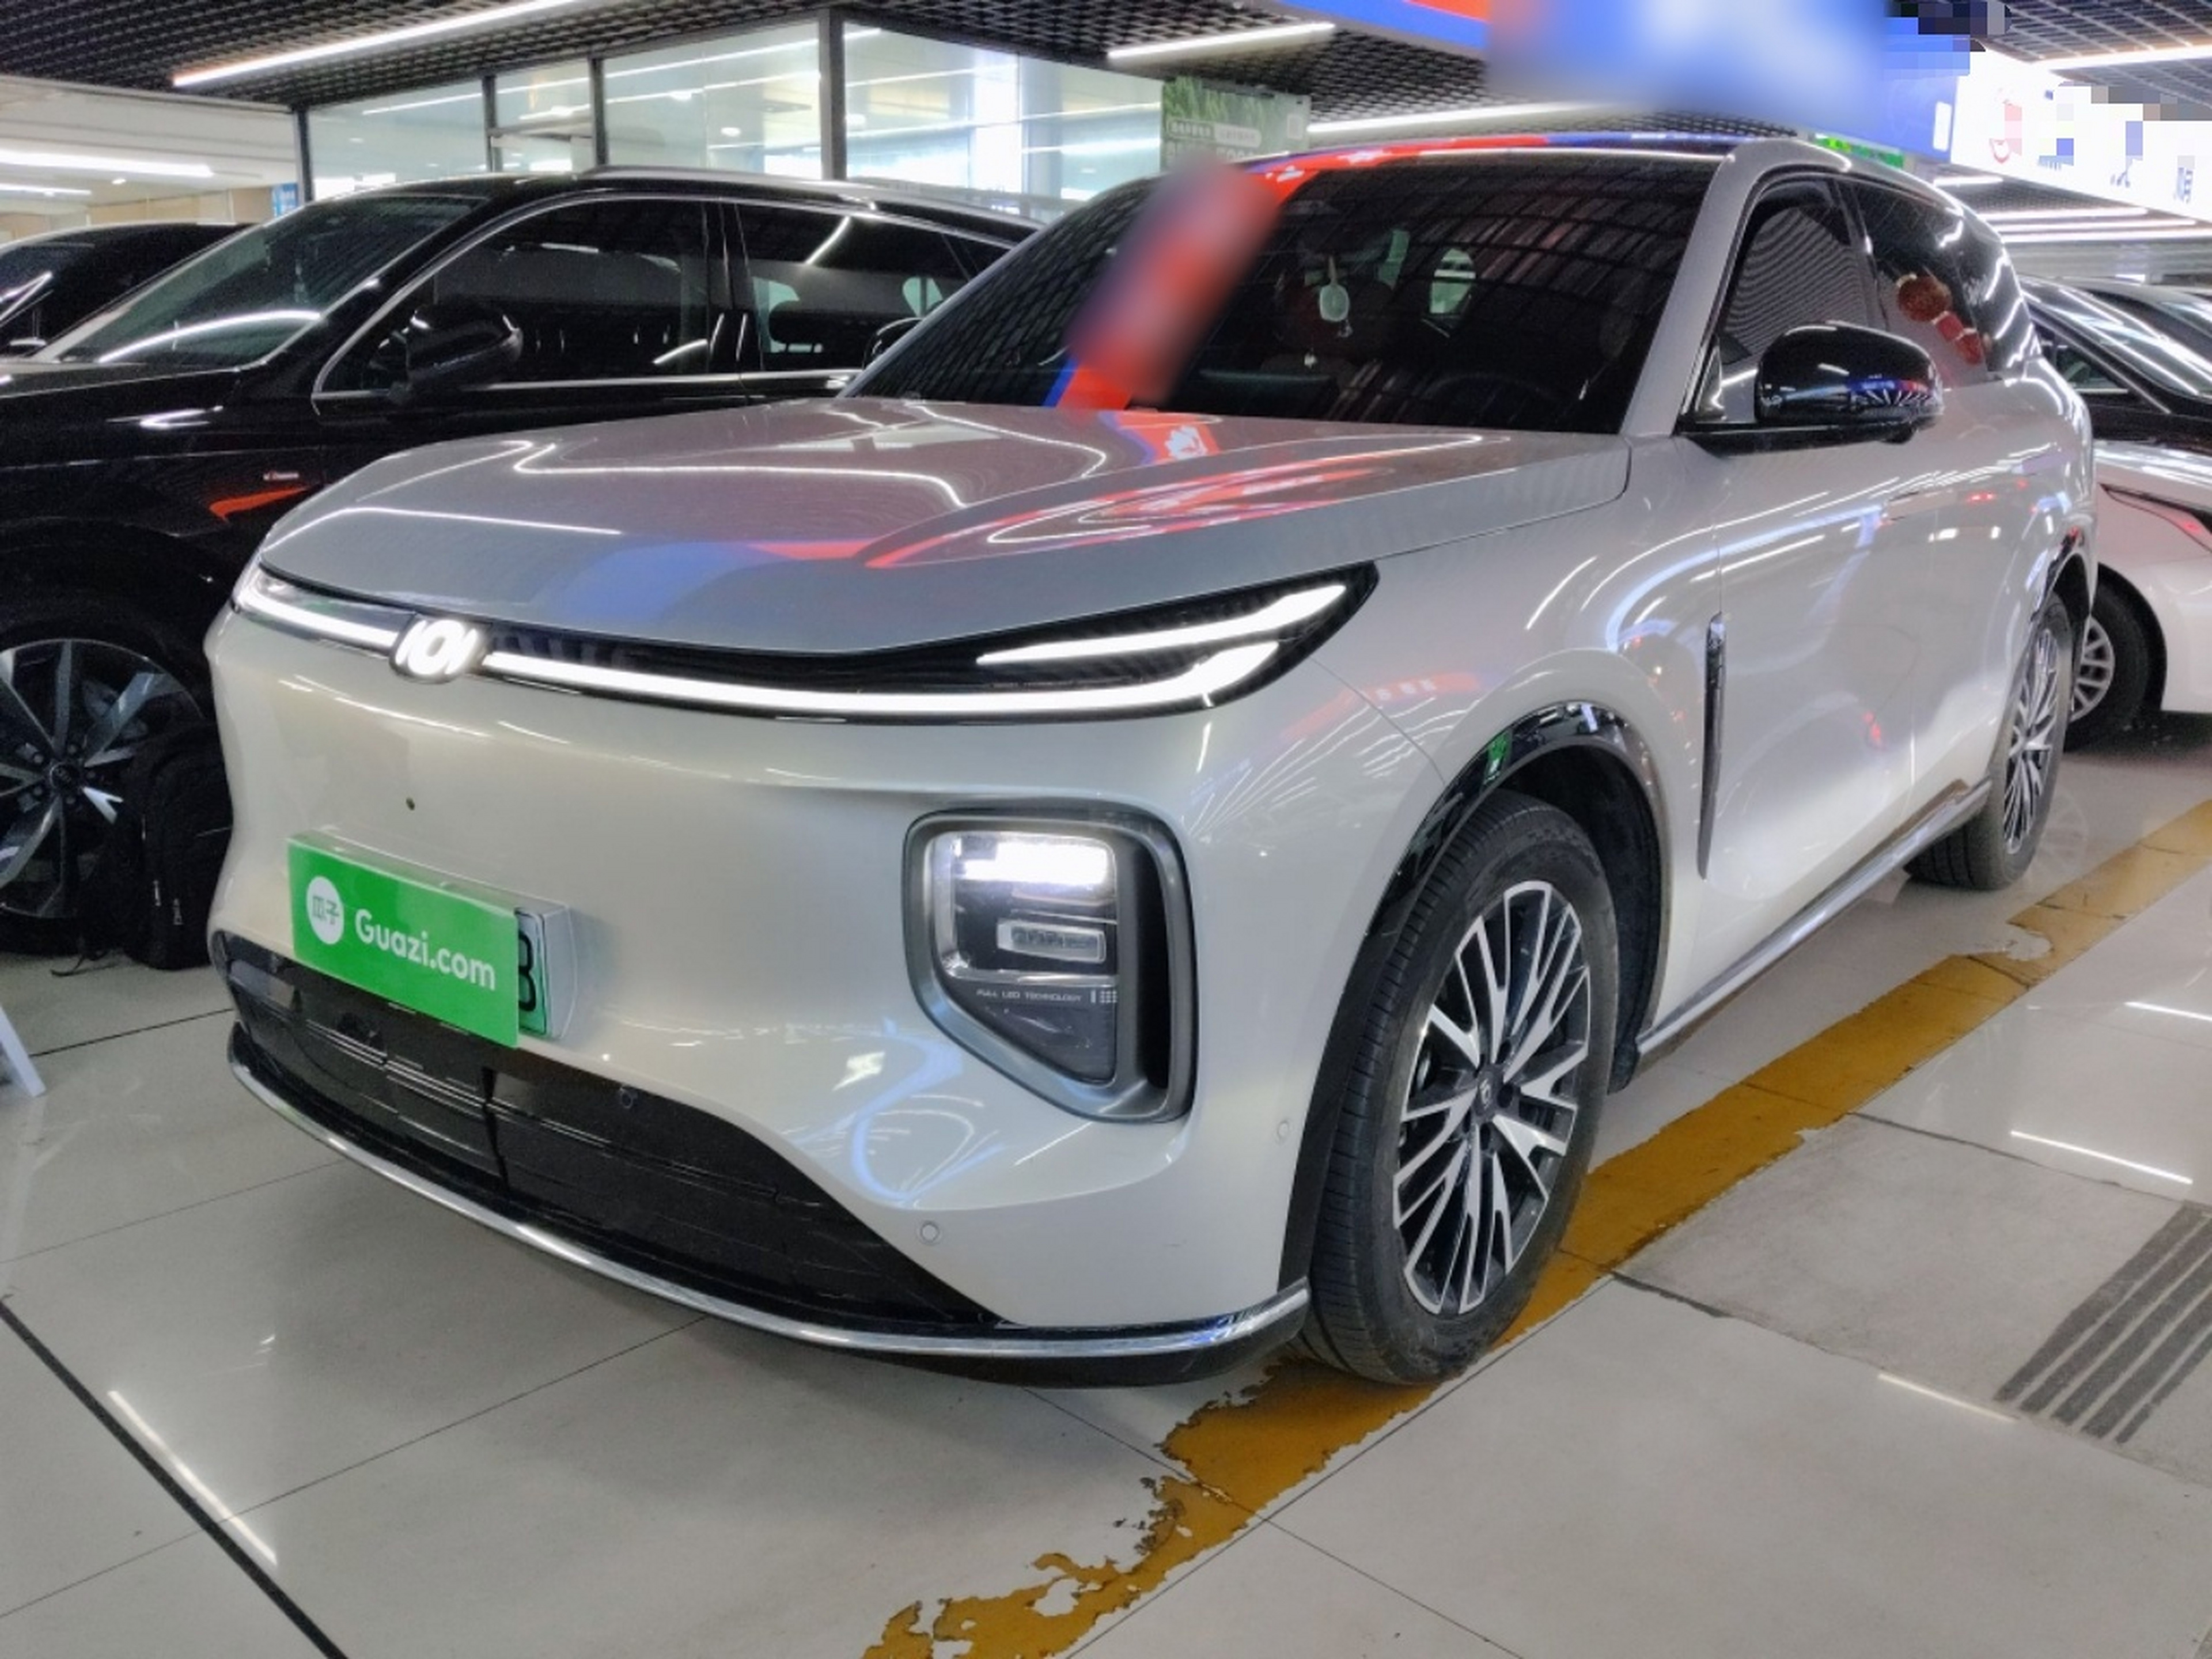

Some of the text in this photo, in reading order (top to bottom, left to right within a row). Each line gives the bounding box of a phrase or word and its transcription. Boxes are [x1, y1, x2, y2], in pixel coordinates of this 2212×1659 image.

[355, 908, 496, 991] Guazi.com
[976, 989, 1082, 1002] FULL LED TECHNOLOGY
